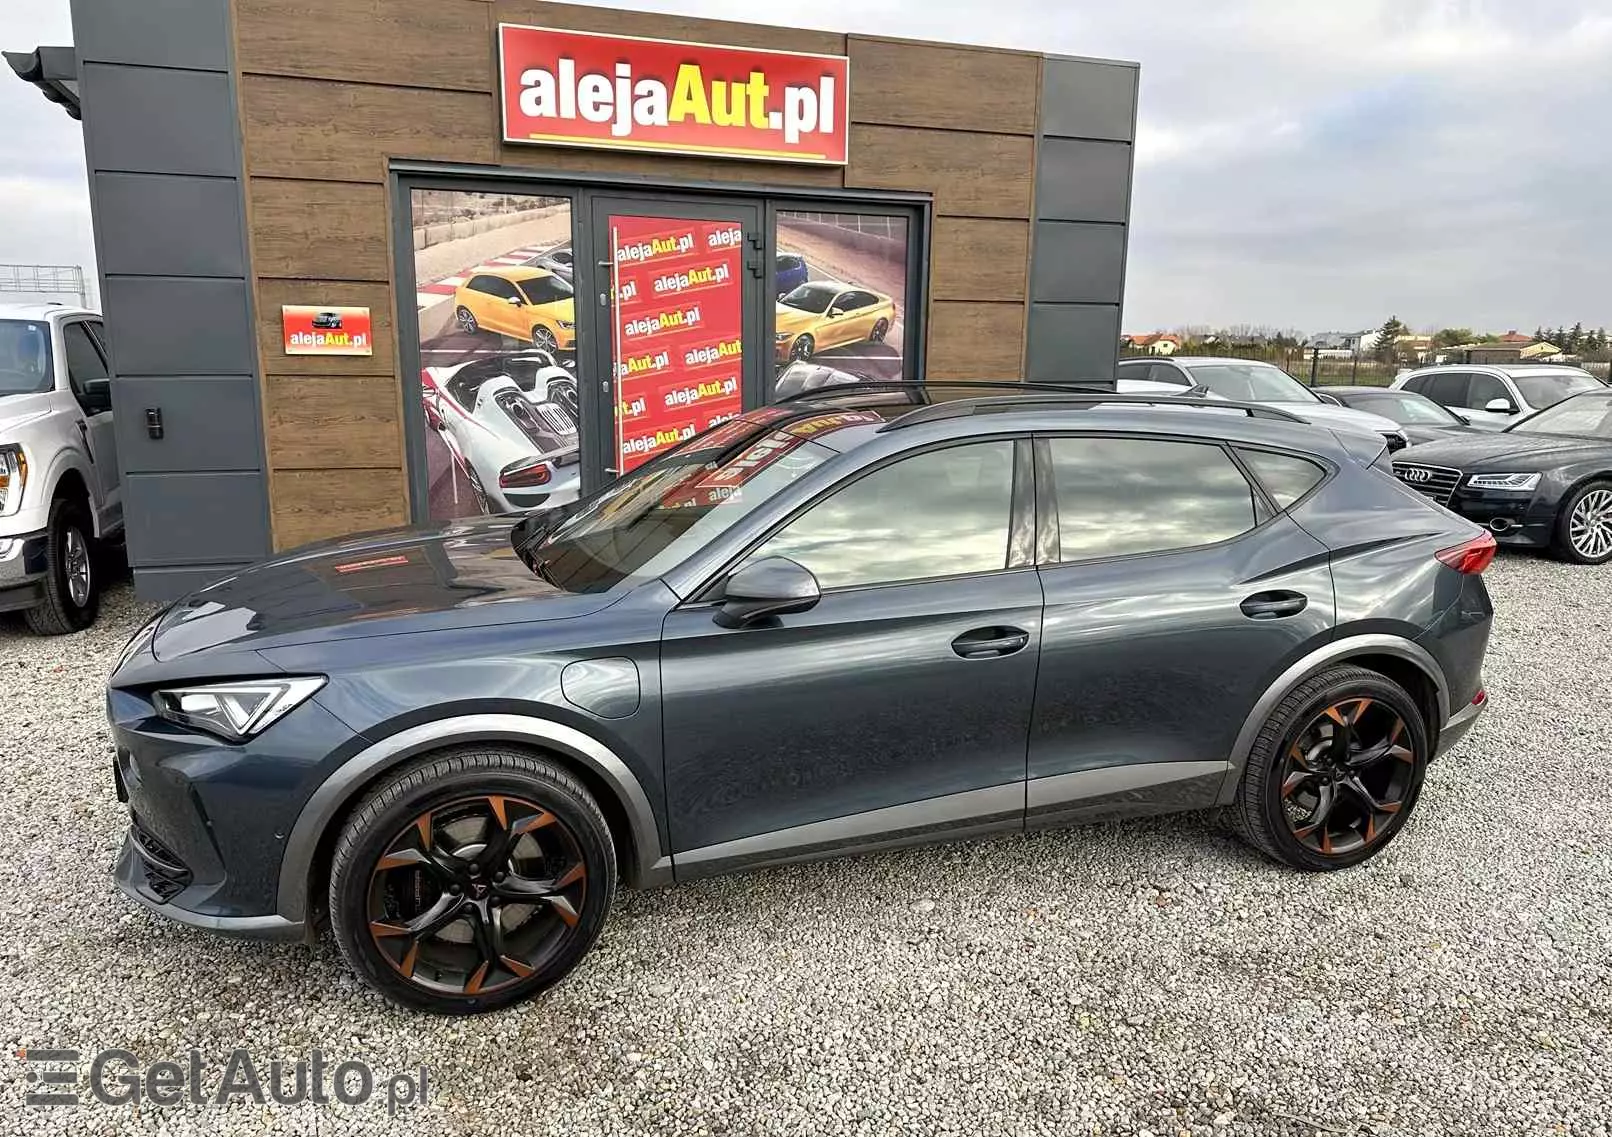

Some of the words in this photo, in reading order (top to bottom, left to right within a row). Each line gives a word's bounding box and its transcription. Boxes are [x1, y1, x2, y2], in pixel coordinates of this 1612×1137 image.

[519, 58, 835, 144] alejaAut.pl
[617, 233, 693, 261] alejaAut.pl
[708, 227, 742, 247] aleja
[654, 264, 729, 291] alejaAut.pl
[625, 307, 700, 336] alejaAut.pl
[290, 332, 367, 348] alejaAut.pl
[685, 339, 742, 364] alejaAut
[664, 378, 737, 404] alejaAut.pl
[623, 425, 695, 452] alejaAut.pl
